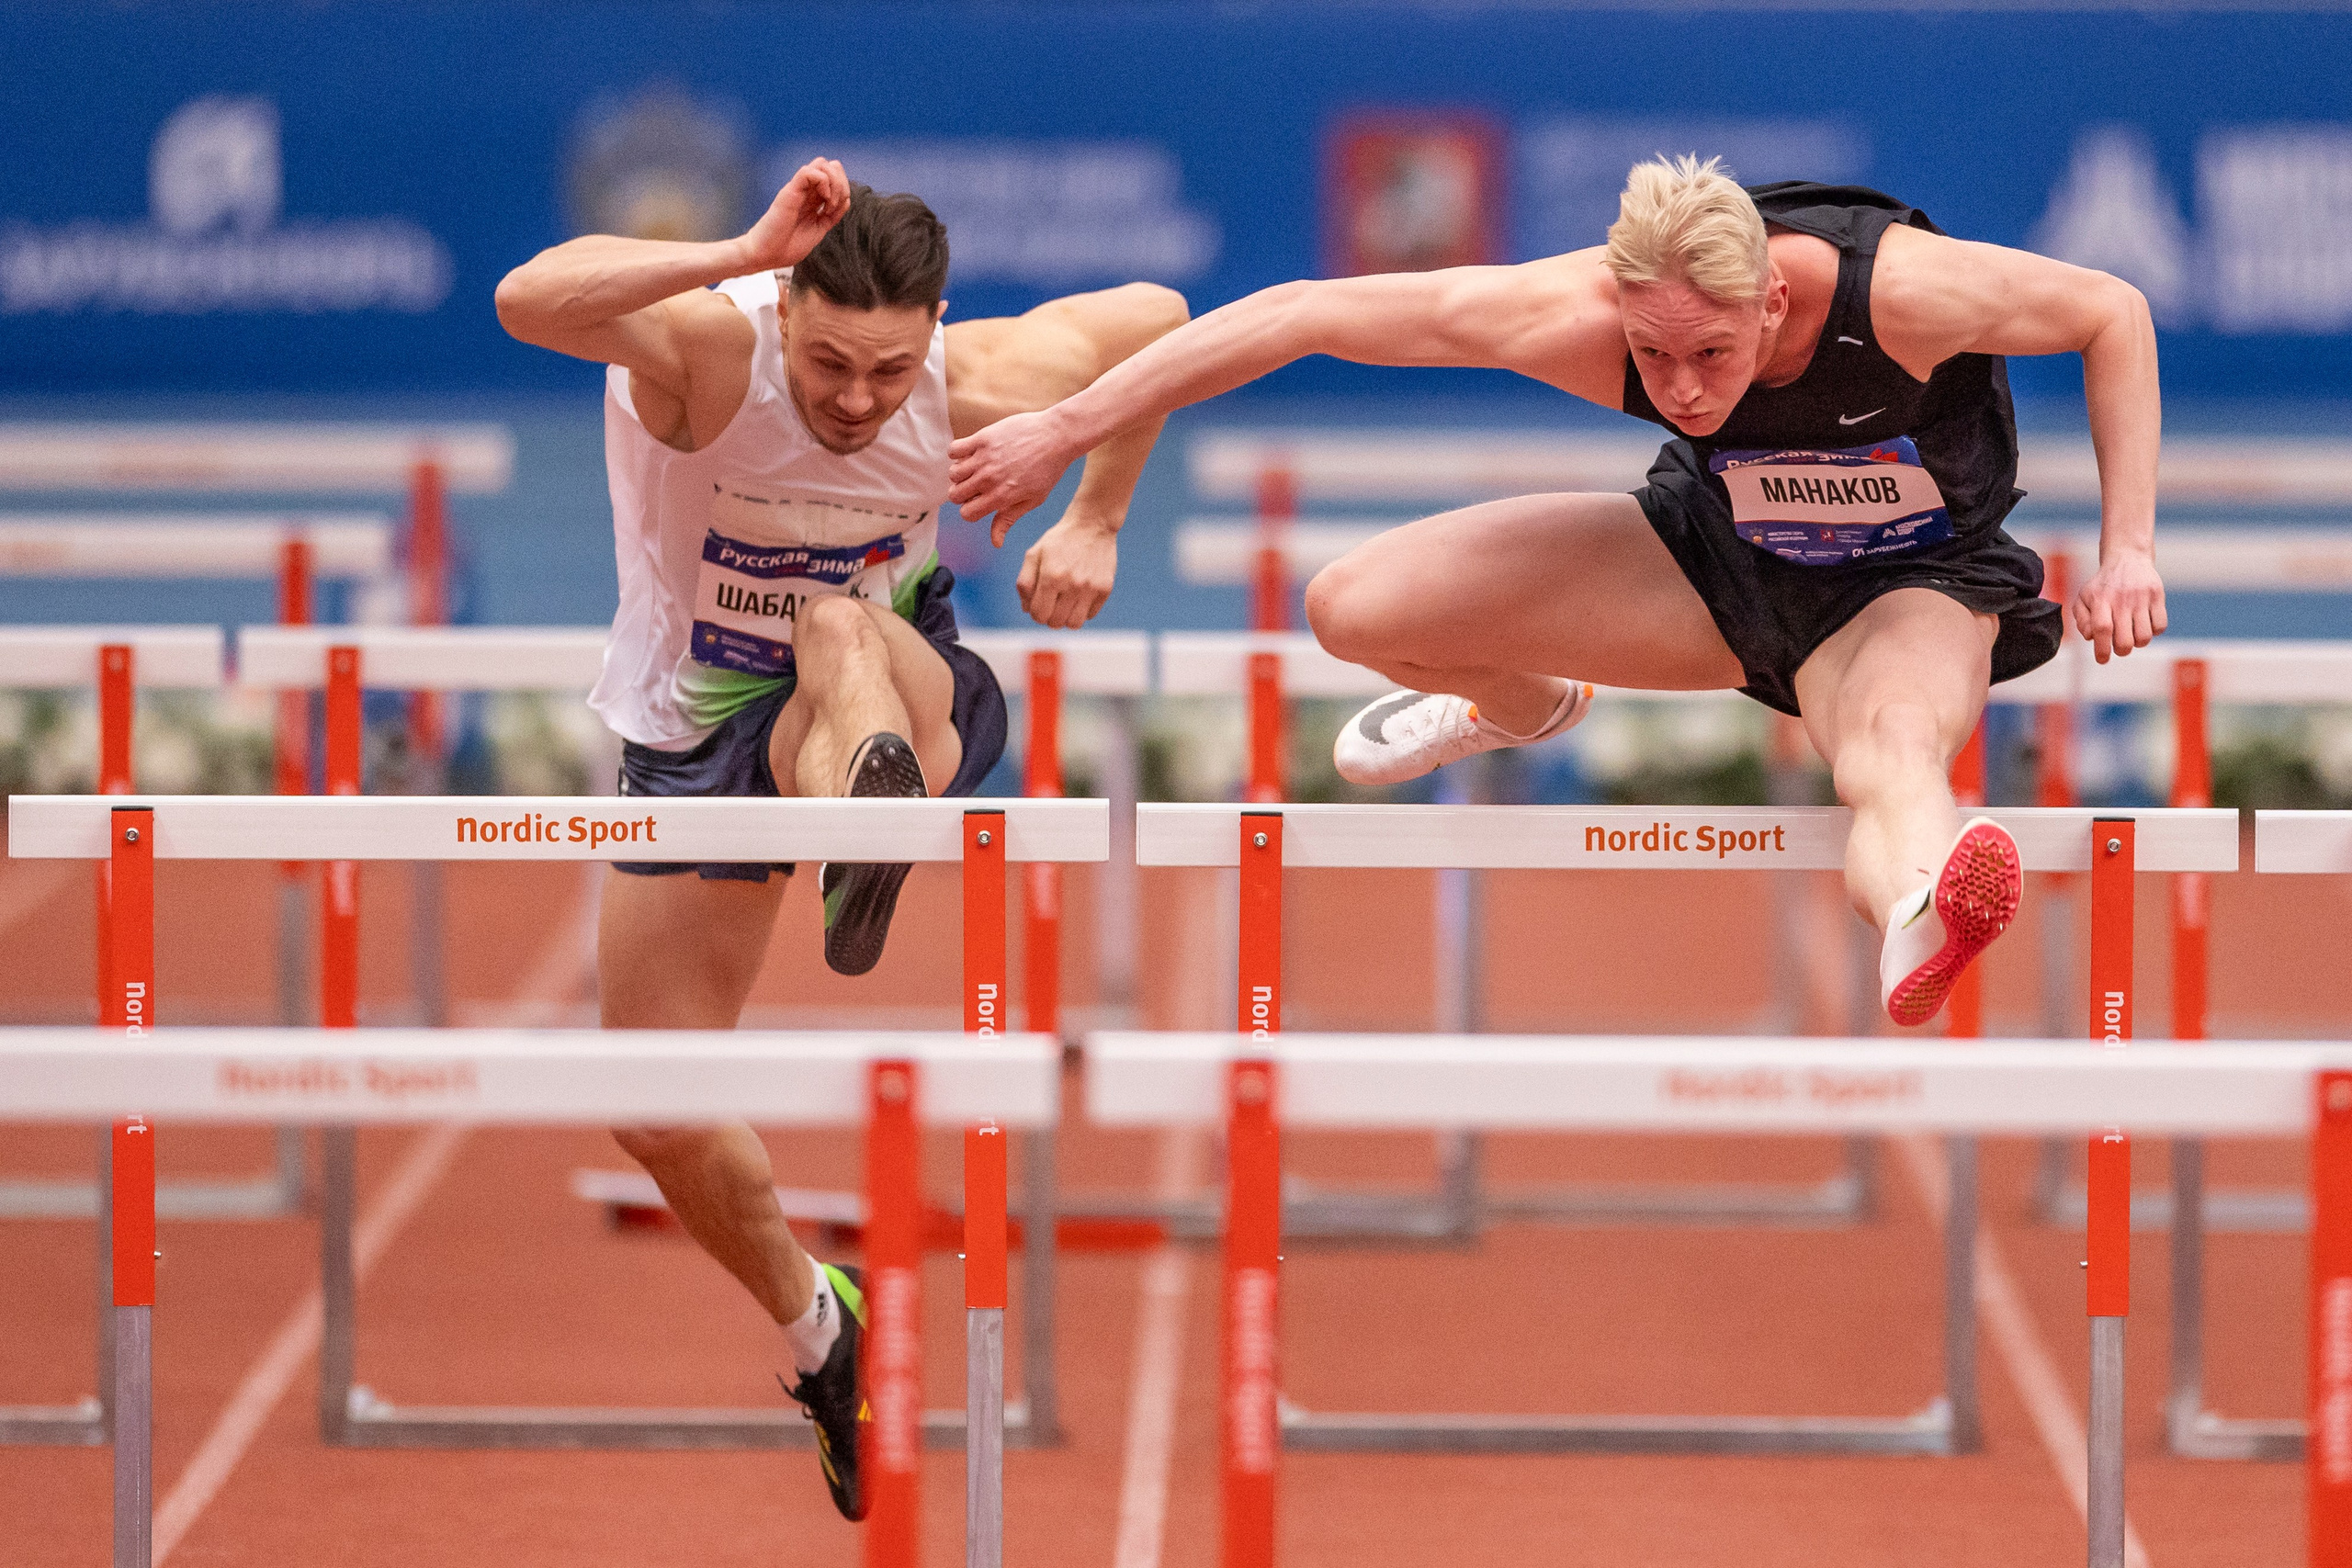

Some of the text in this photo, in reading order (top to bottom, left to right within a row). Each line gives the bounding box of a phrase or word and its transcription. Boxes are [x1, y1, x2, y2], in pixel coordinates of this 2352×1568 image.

[1759, 477, 1902, 505] МАНАКОВ
[719, 547, 810, 569] Русская
[717, 582, 807, 623] ШАБА
[457, 813, 658, 851] nordic Sport
[1585, 822, 1785, 860] nordic Sport
